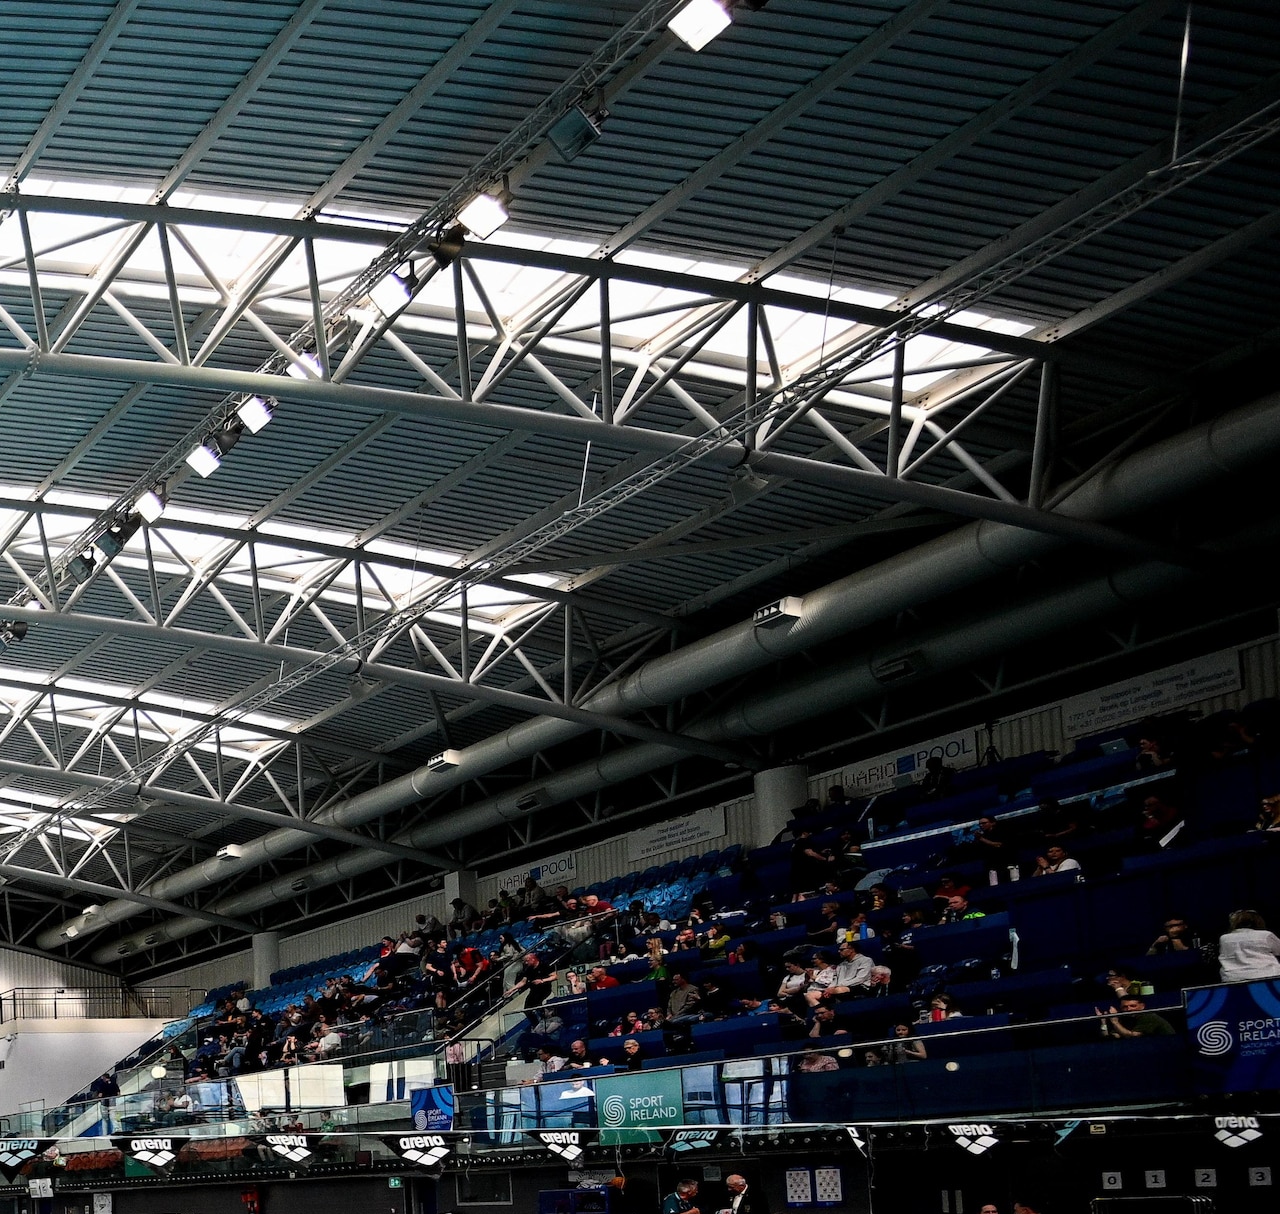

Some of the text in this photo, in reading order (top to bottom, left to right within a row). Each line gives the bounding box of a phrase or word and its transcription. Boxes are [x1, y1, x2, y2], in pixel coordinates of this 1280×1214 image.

[916, 738, 973, 768] POOL
[541, 853, 575, 877] POOL
[1238, 1018, 1280, 1031] SPORT
[1239, 1029, 1280, 1042] IRELA
[630, 1095, 664, 1109] SPORT
[630, 1106, 677, 1121] IRELAND
[1215, 1116, 1260, 1128] arena
[675, 1130, 718, 1140] arena
[948, 1124, 993, 1135] arena
[266, 1135, 307, 1147] arena
[399, 1135, 445, 1149] arena
[540, 1132, 579, 1144] arena
[131, 1139, 172, 1150] arena
[1107, 1176, 1117, 1185] 0
[1152, 1174, 1160, 1184] 1
[1201, 1172, 1211, 1183] 2
[1255, 1171, 1265, 1181] 3
